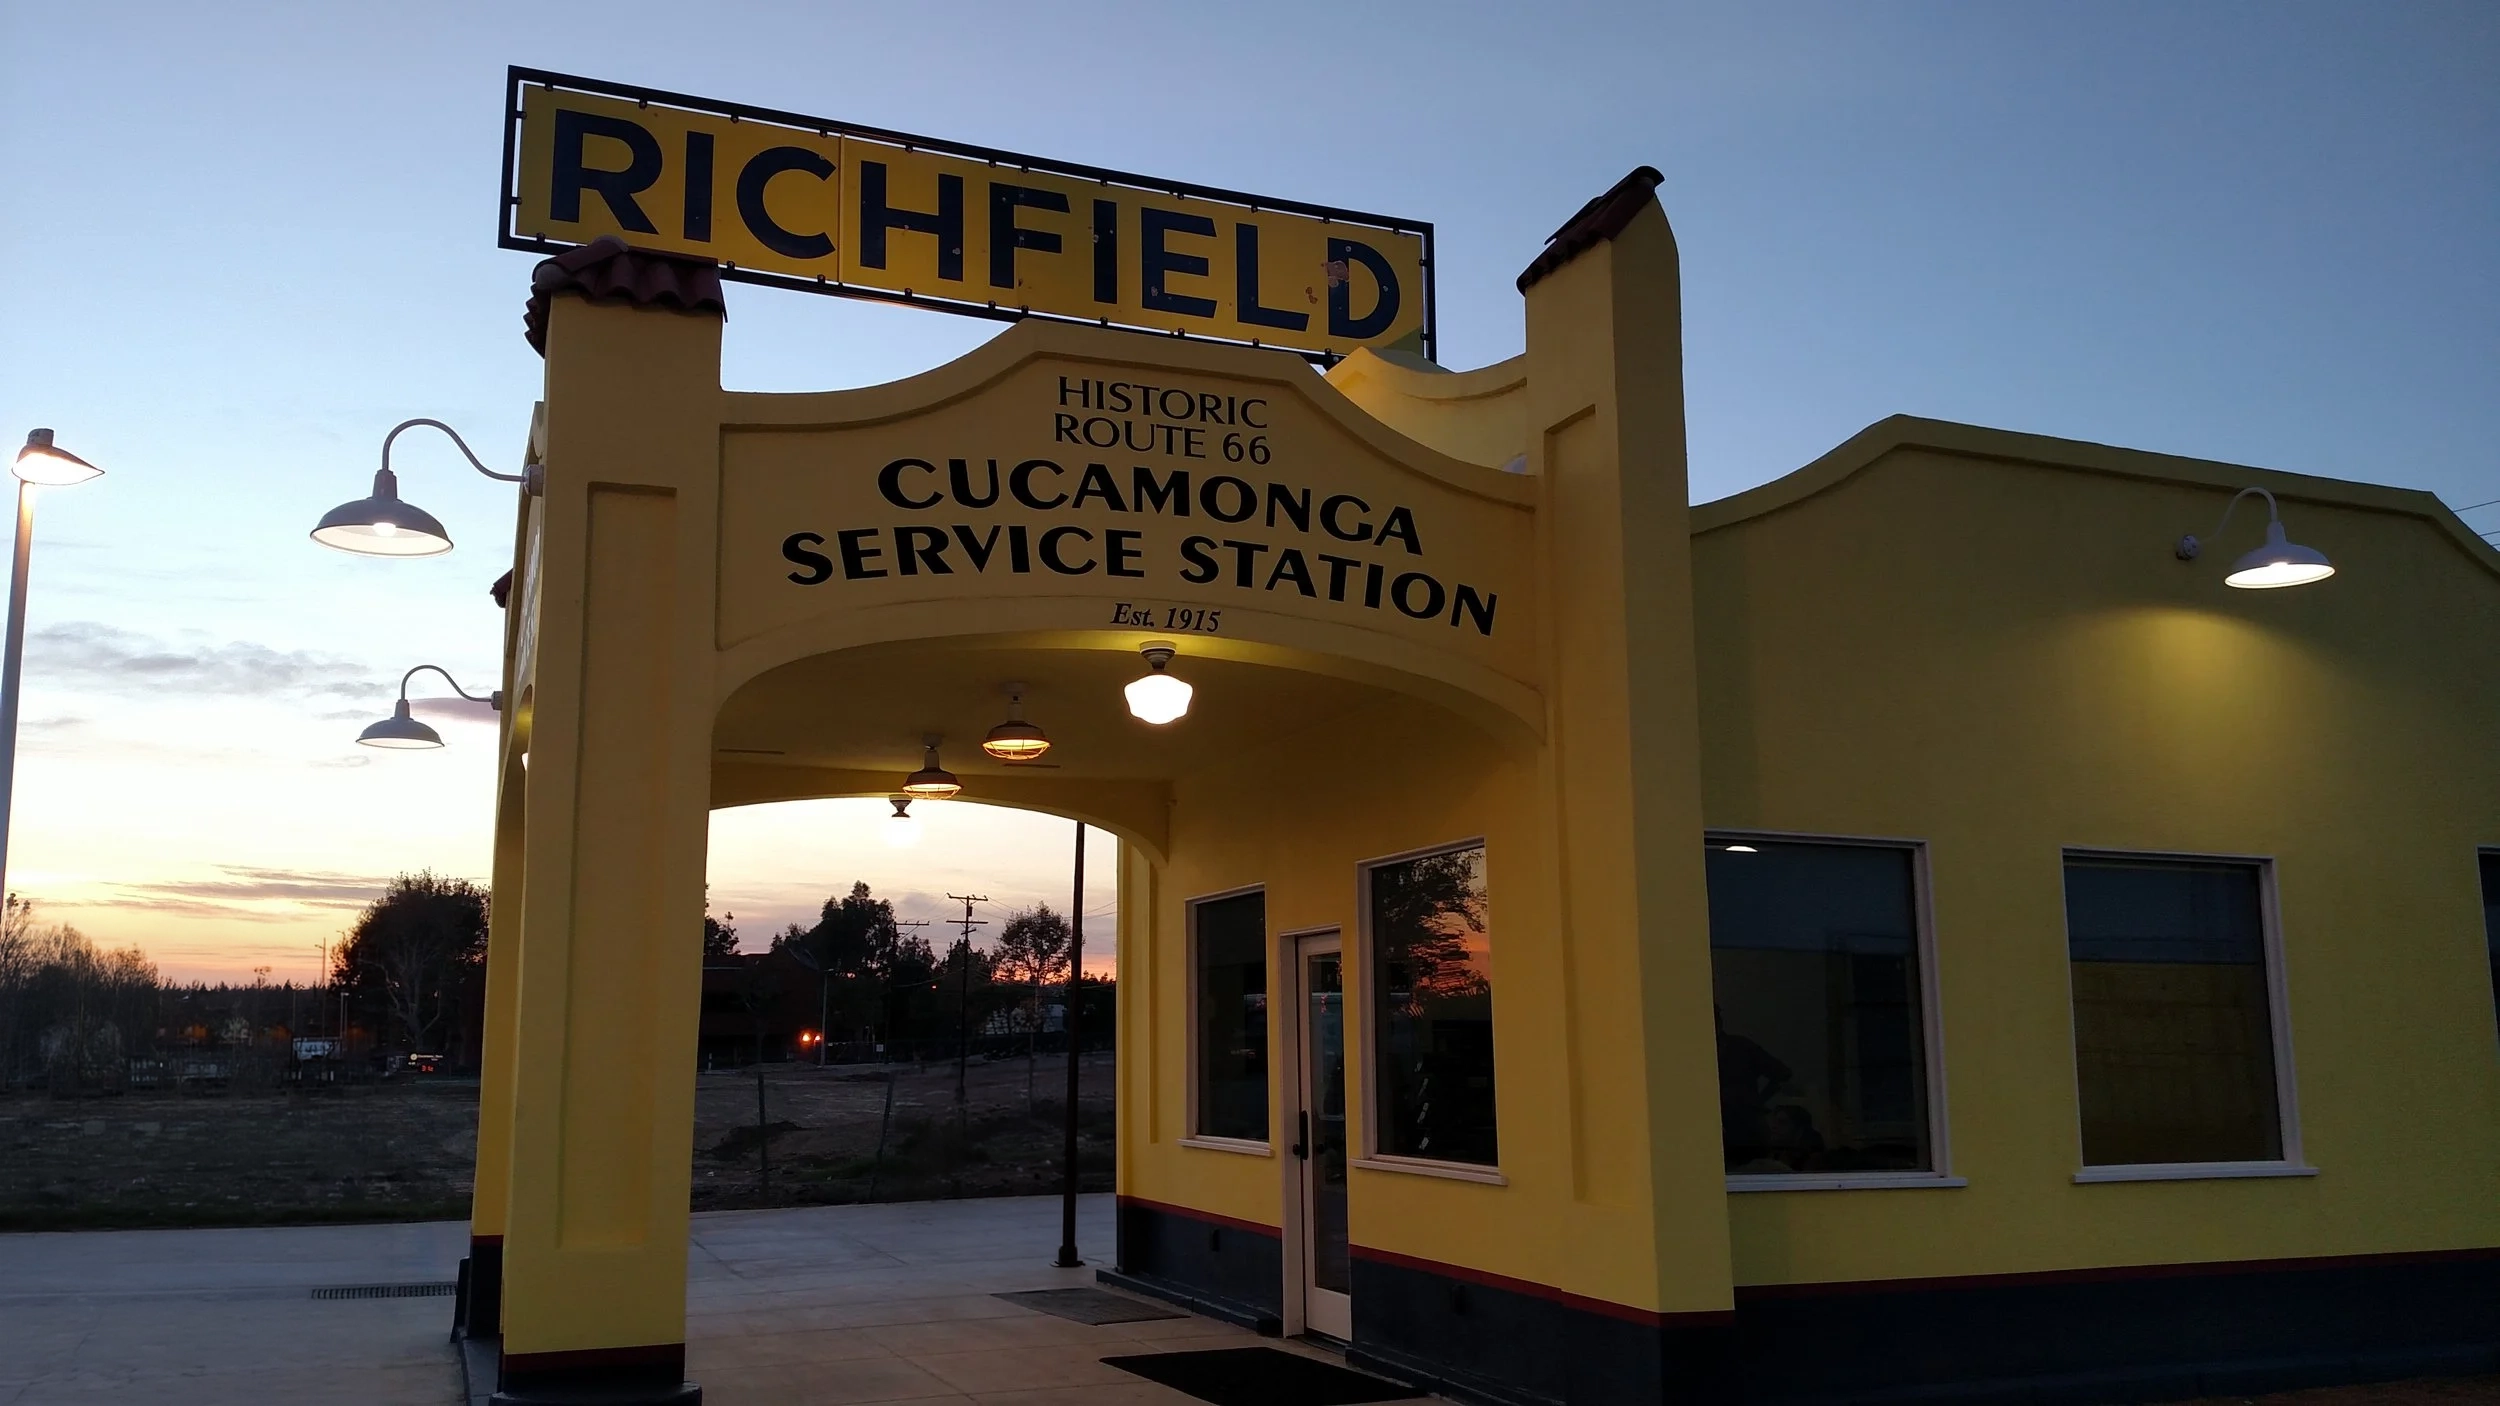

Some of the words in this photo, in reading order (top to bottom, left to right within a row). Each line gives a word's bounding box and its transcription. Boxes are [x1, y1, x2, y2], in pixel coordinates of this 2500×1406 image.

[549, 108, 1400, 339] RICHFIELD
[1054, 413, 1206, 459] ROUTE
[1222, 433, 1272, 466] 66
[1058, 376, 1268, 429] HISTORIC
[877, 458, 1424, 556] CUCAMONGA
[781, 524, 1145, 586] SERVICE
[1179, 535, 1498, 637] STATION
[1110, 602, 1155, 628] Est.
[1164, 607, 1222, 633] 1915
